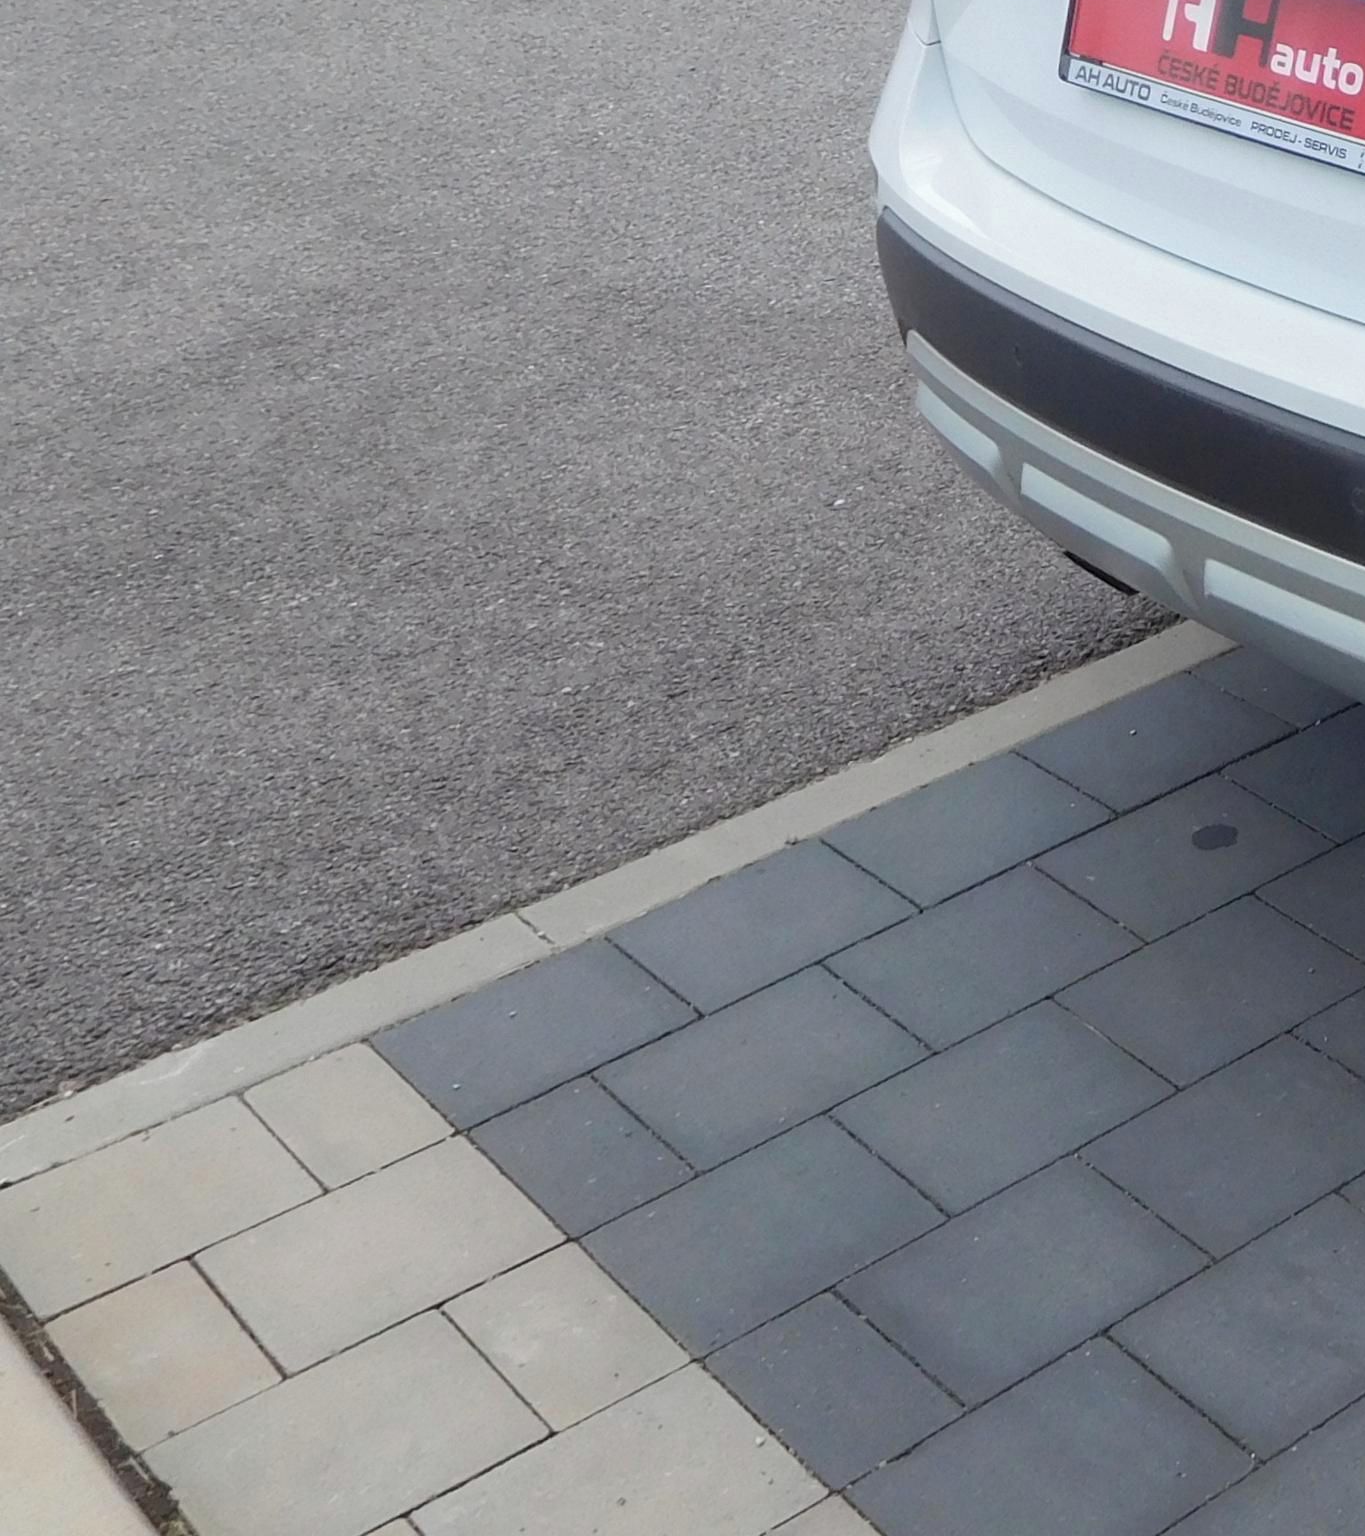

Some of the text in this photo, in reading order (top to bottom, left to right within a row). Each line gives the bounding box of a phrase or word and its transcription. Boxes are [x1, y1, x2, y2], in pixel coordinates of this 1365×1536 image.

[1157, 49, 1220, 90] ČESKÉ
[1270, 43, 1364, 96] auto
[1075, 66, 1100, 86] AH
[1102, 72, 1152, 102] AUTO
[1250, 121, 1299, 144] PRODEJ
[1304, 137, 1348, 160] SERVIS
